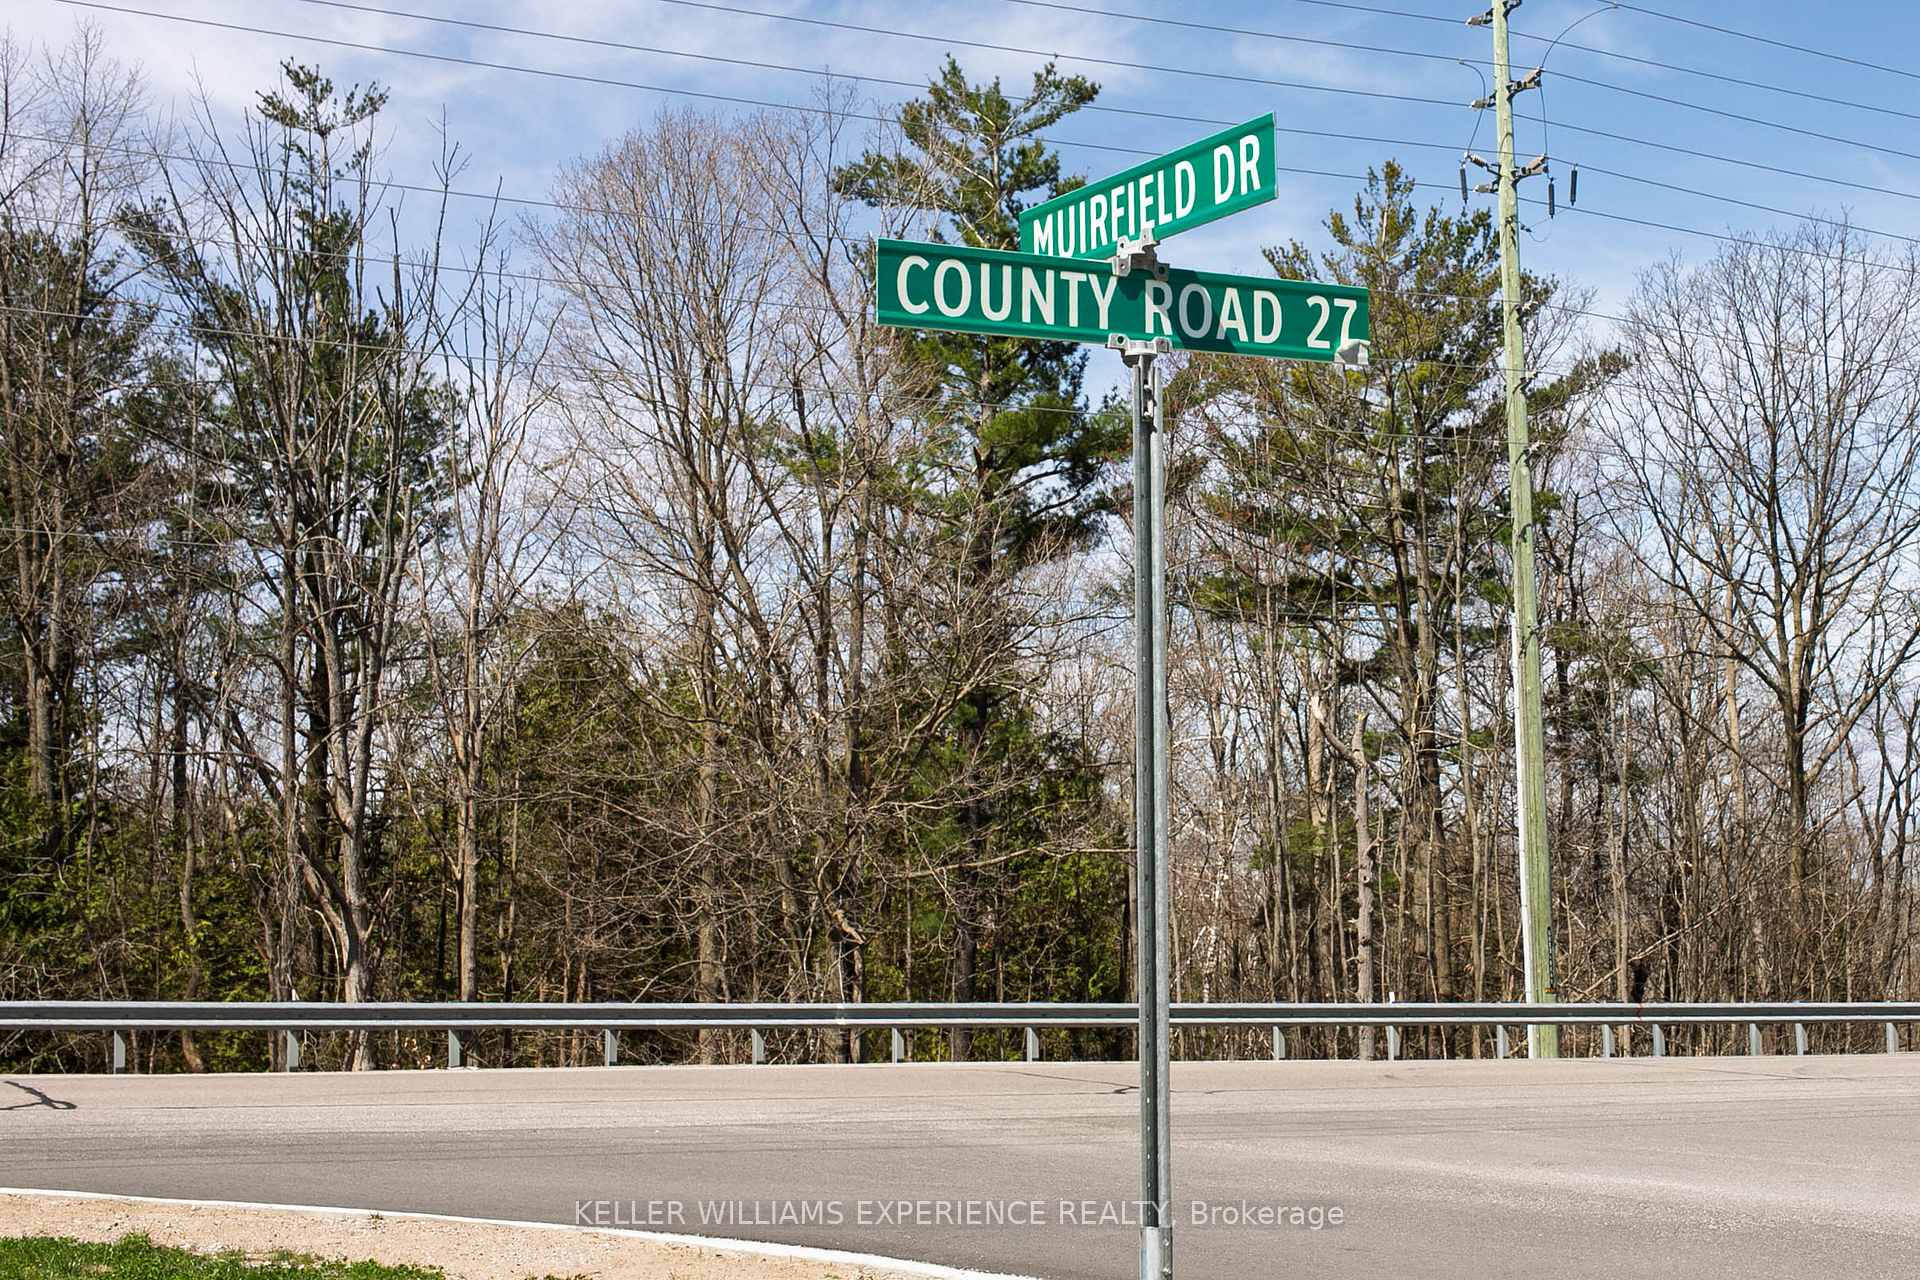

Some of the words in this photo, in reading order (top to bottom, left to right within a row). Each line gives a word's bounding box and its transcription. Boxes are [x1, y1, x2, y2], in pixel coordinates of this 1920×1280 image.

[1033, 160, 1196, 258] MUIRFIELD
[1213, 134, 1261, 205] DR
[896, 255, 1118, 330] COUNTY
[1144, 279, 1282, 344] ROAD
[1306, 295, 1358, 349] 27
